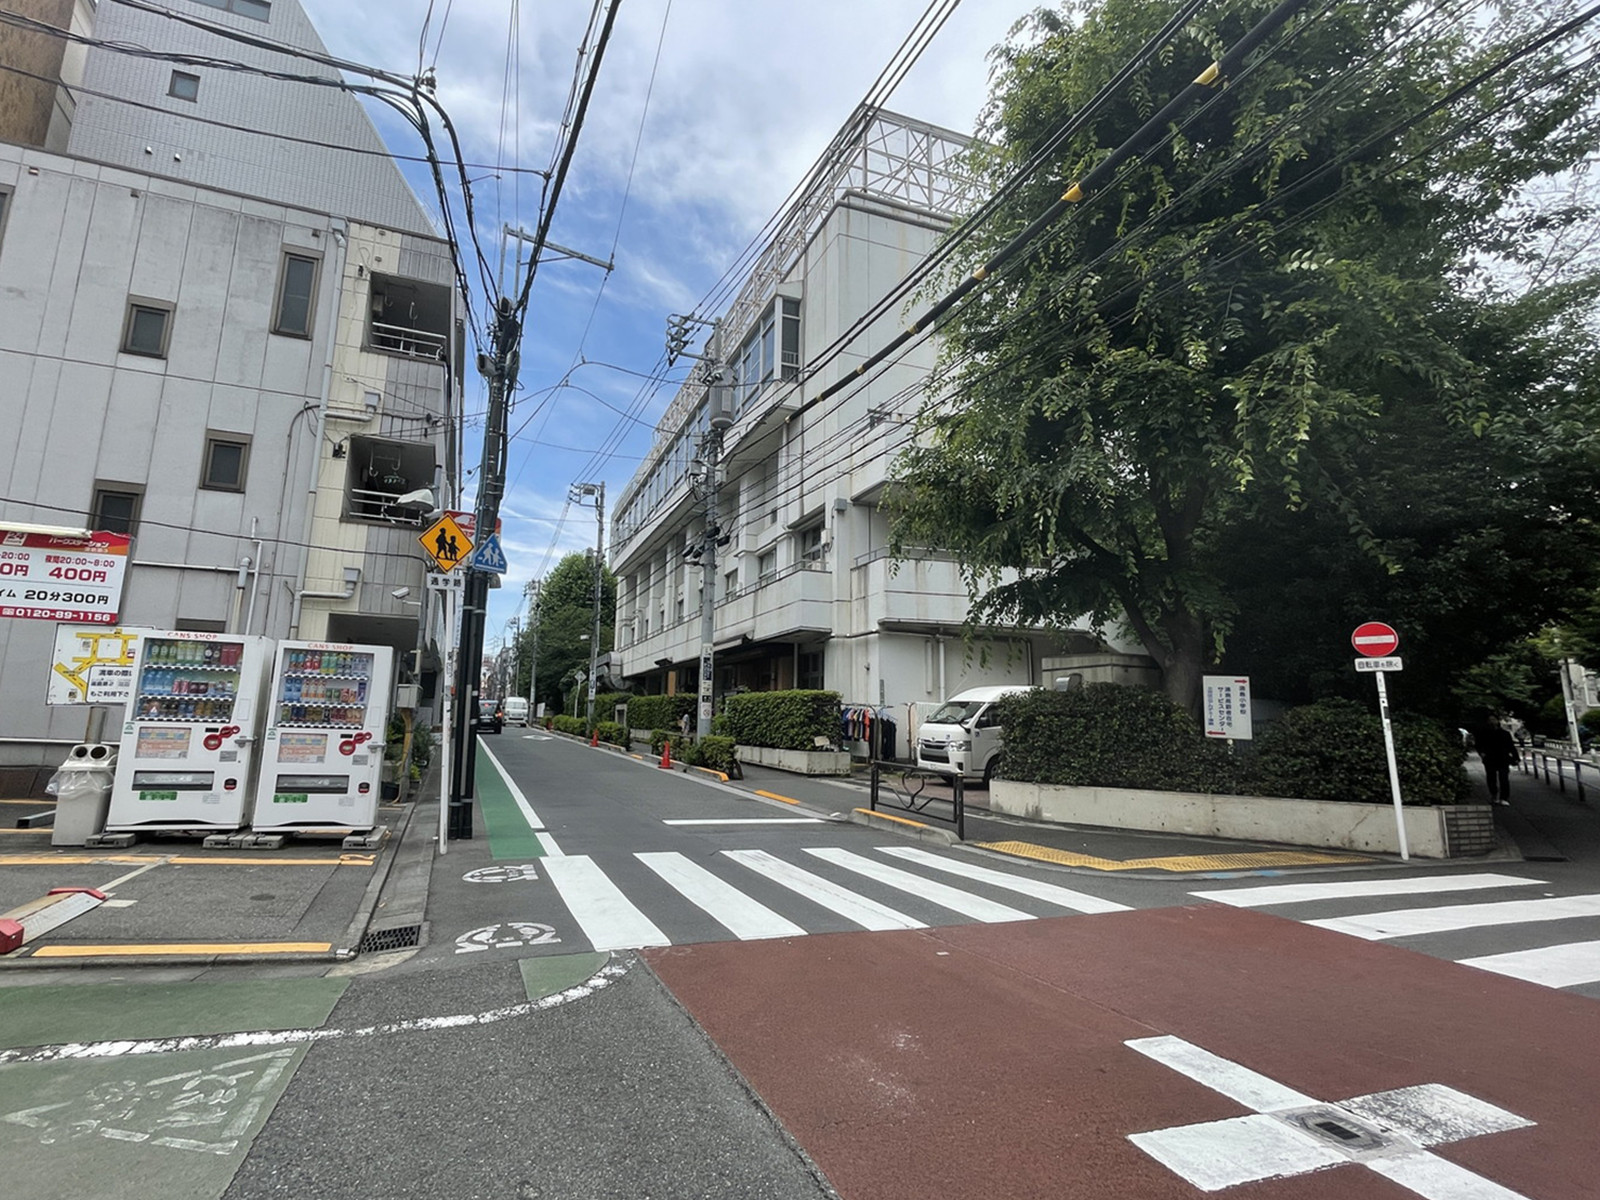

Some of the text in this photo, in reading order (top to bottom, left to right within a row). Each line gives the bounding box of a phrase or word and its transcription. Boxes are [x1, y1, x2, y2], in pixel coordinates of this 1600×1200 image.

[48, 566, 108, 583] 400円
[24, 589, 109, 605] 20分300円
[168, 632, 218, 641] CANS SHOP
